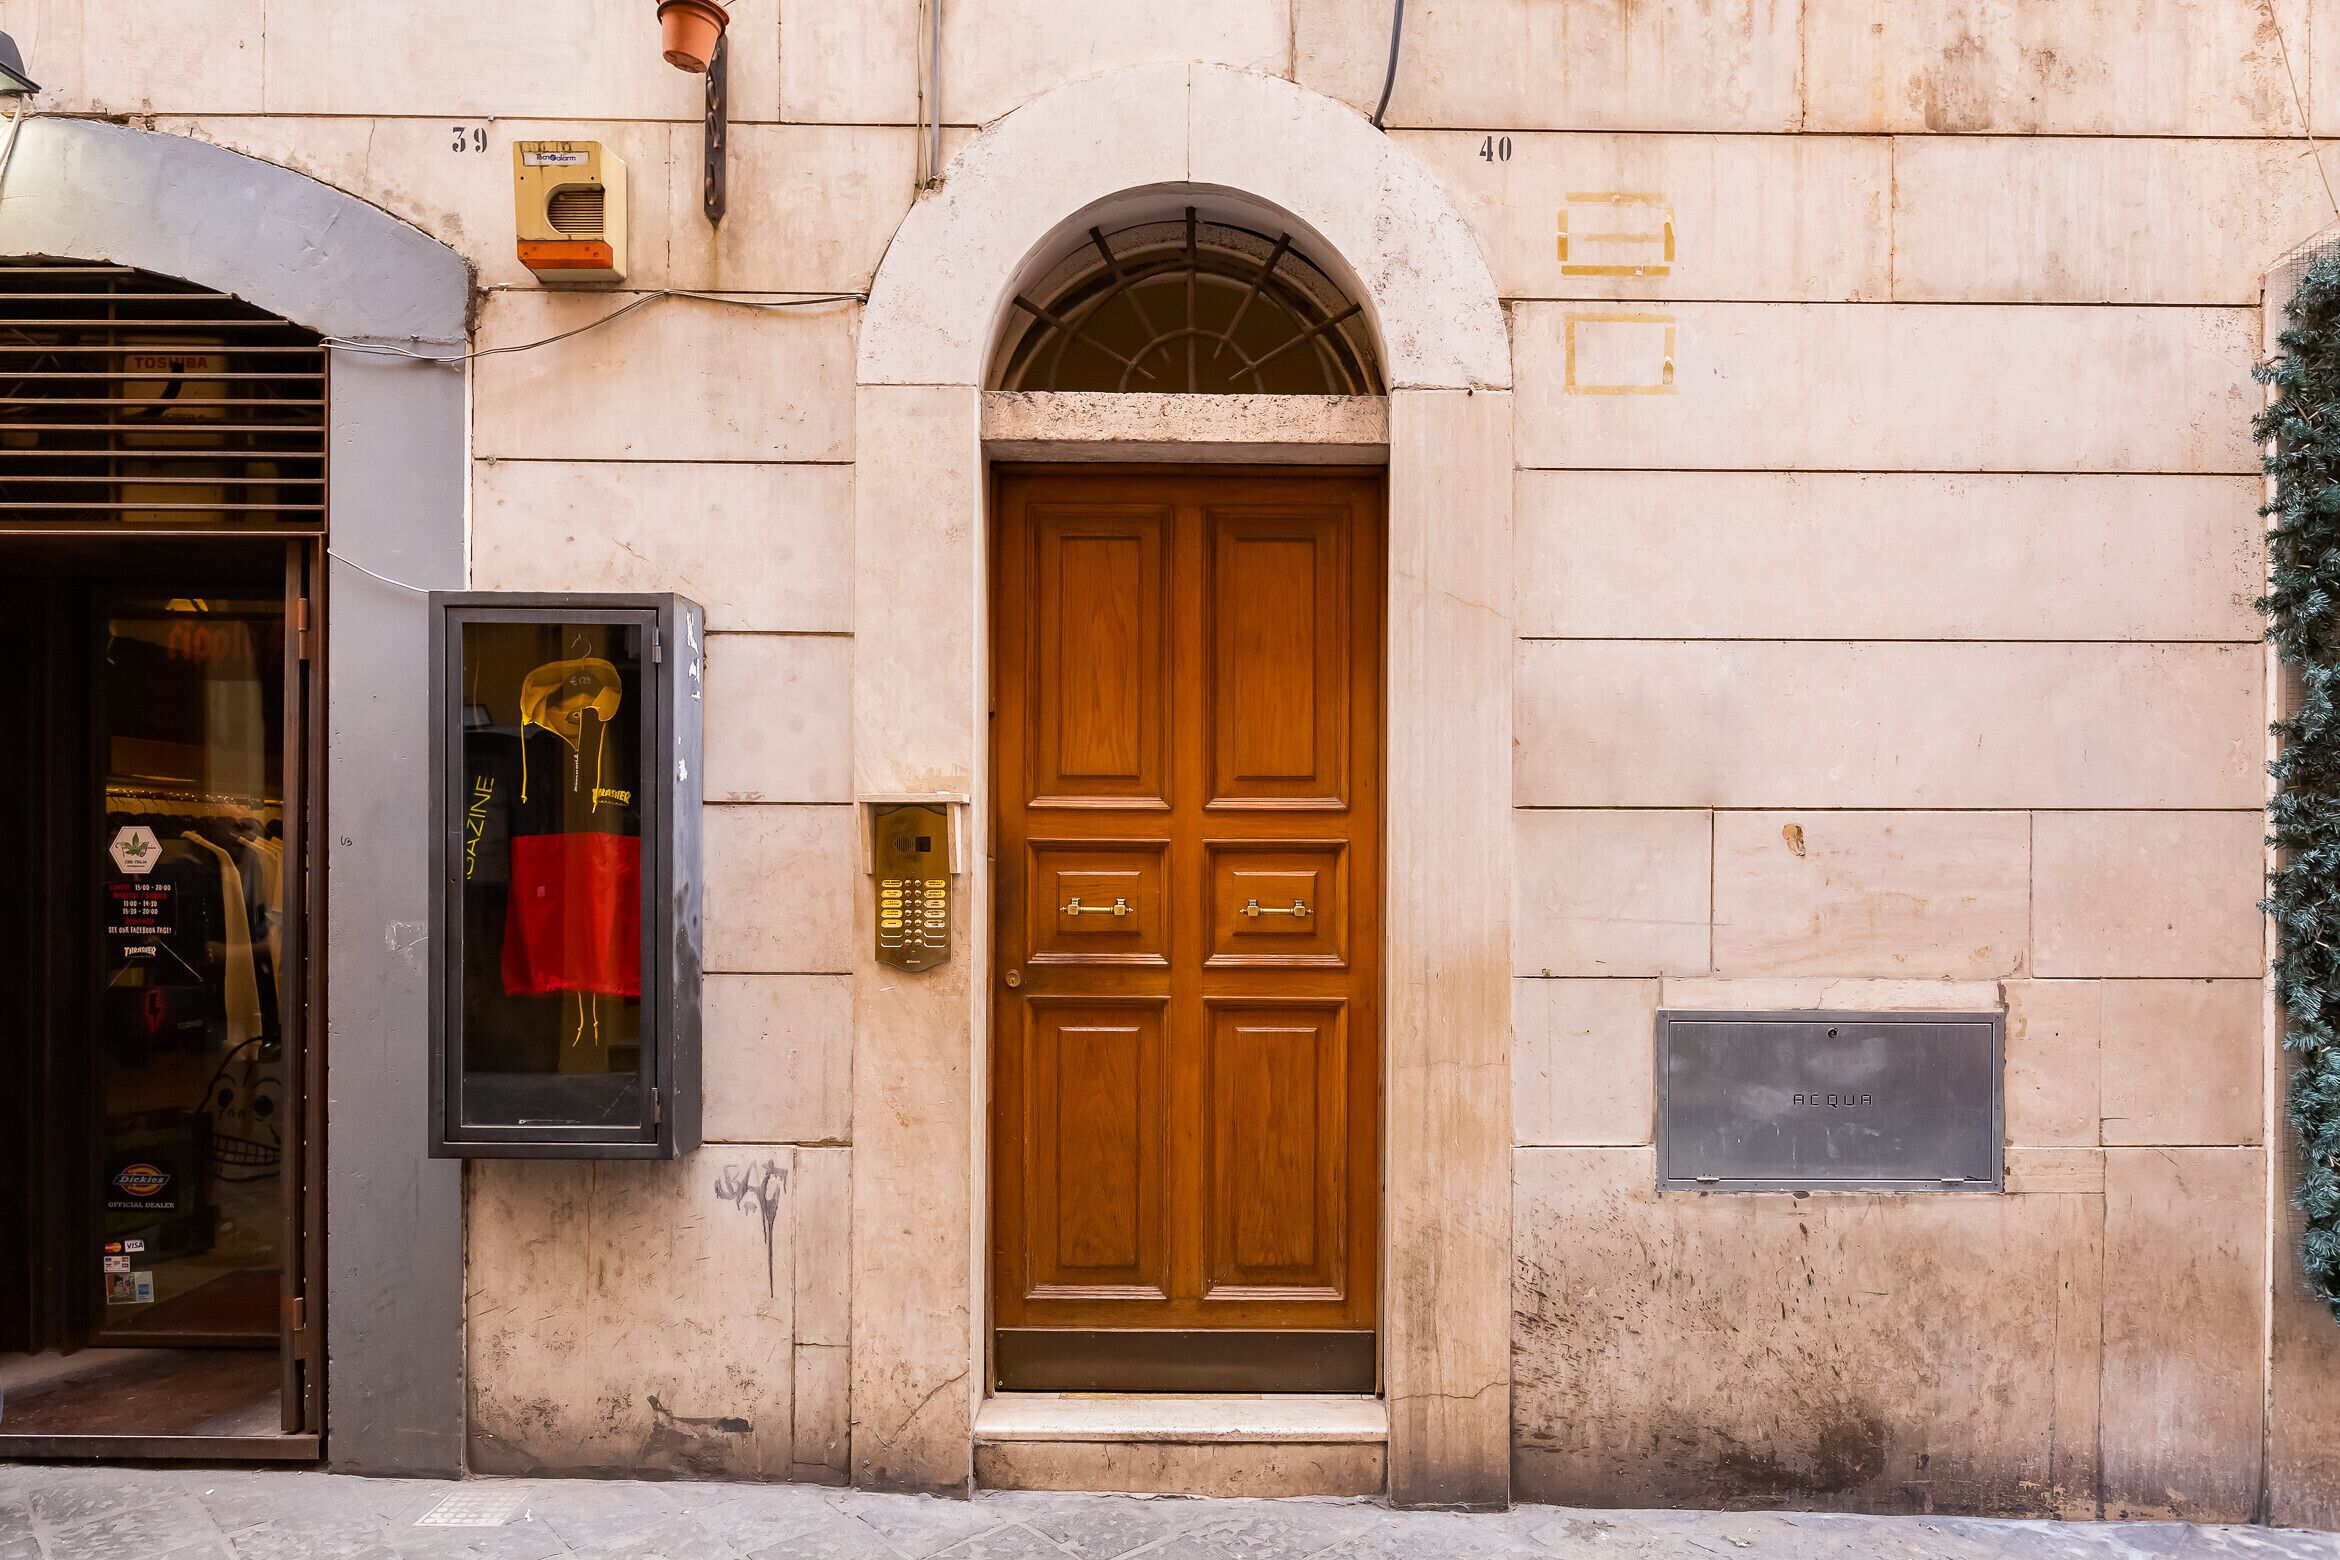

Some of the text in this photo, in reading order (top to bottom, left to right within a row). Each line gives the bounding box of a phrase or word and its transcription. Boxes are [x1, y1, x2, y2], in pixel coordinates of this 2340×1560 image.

[452, 127, 487, 153] 39
[1479, 136, 1512, 162] 40
[123, 946, 157, 957] THRASHER
[1793, 1093, 1873, 1109] ACQUA
[127, 1241, 144, 1249] VISA
